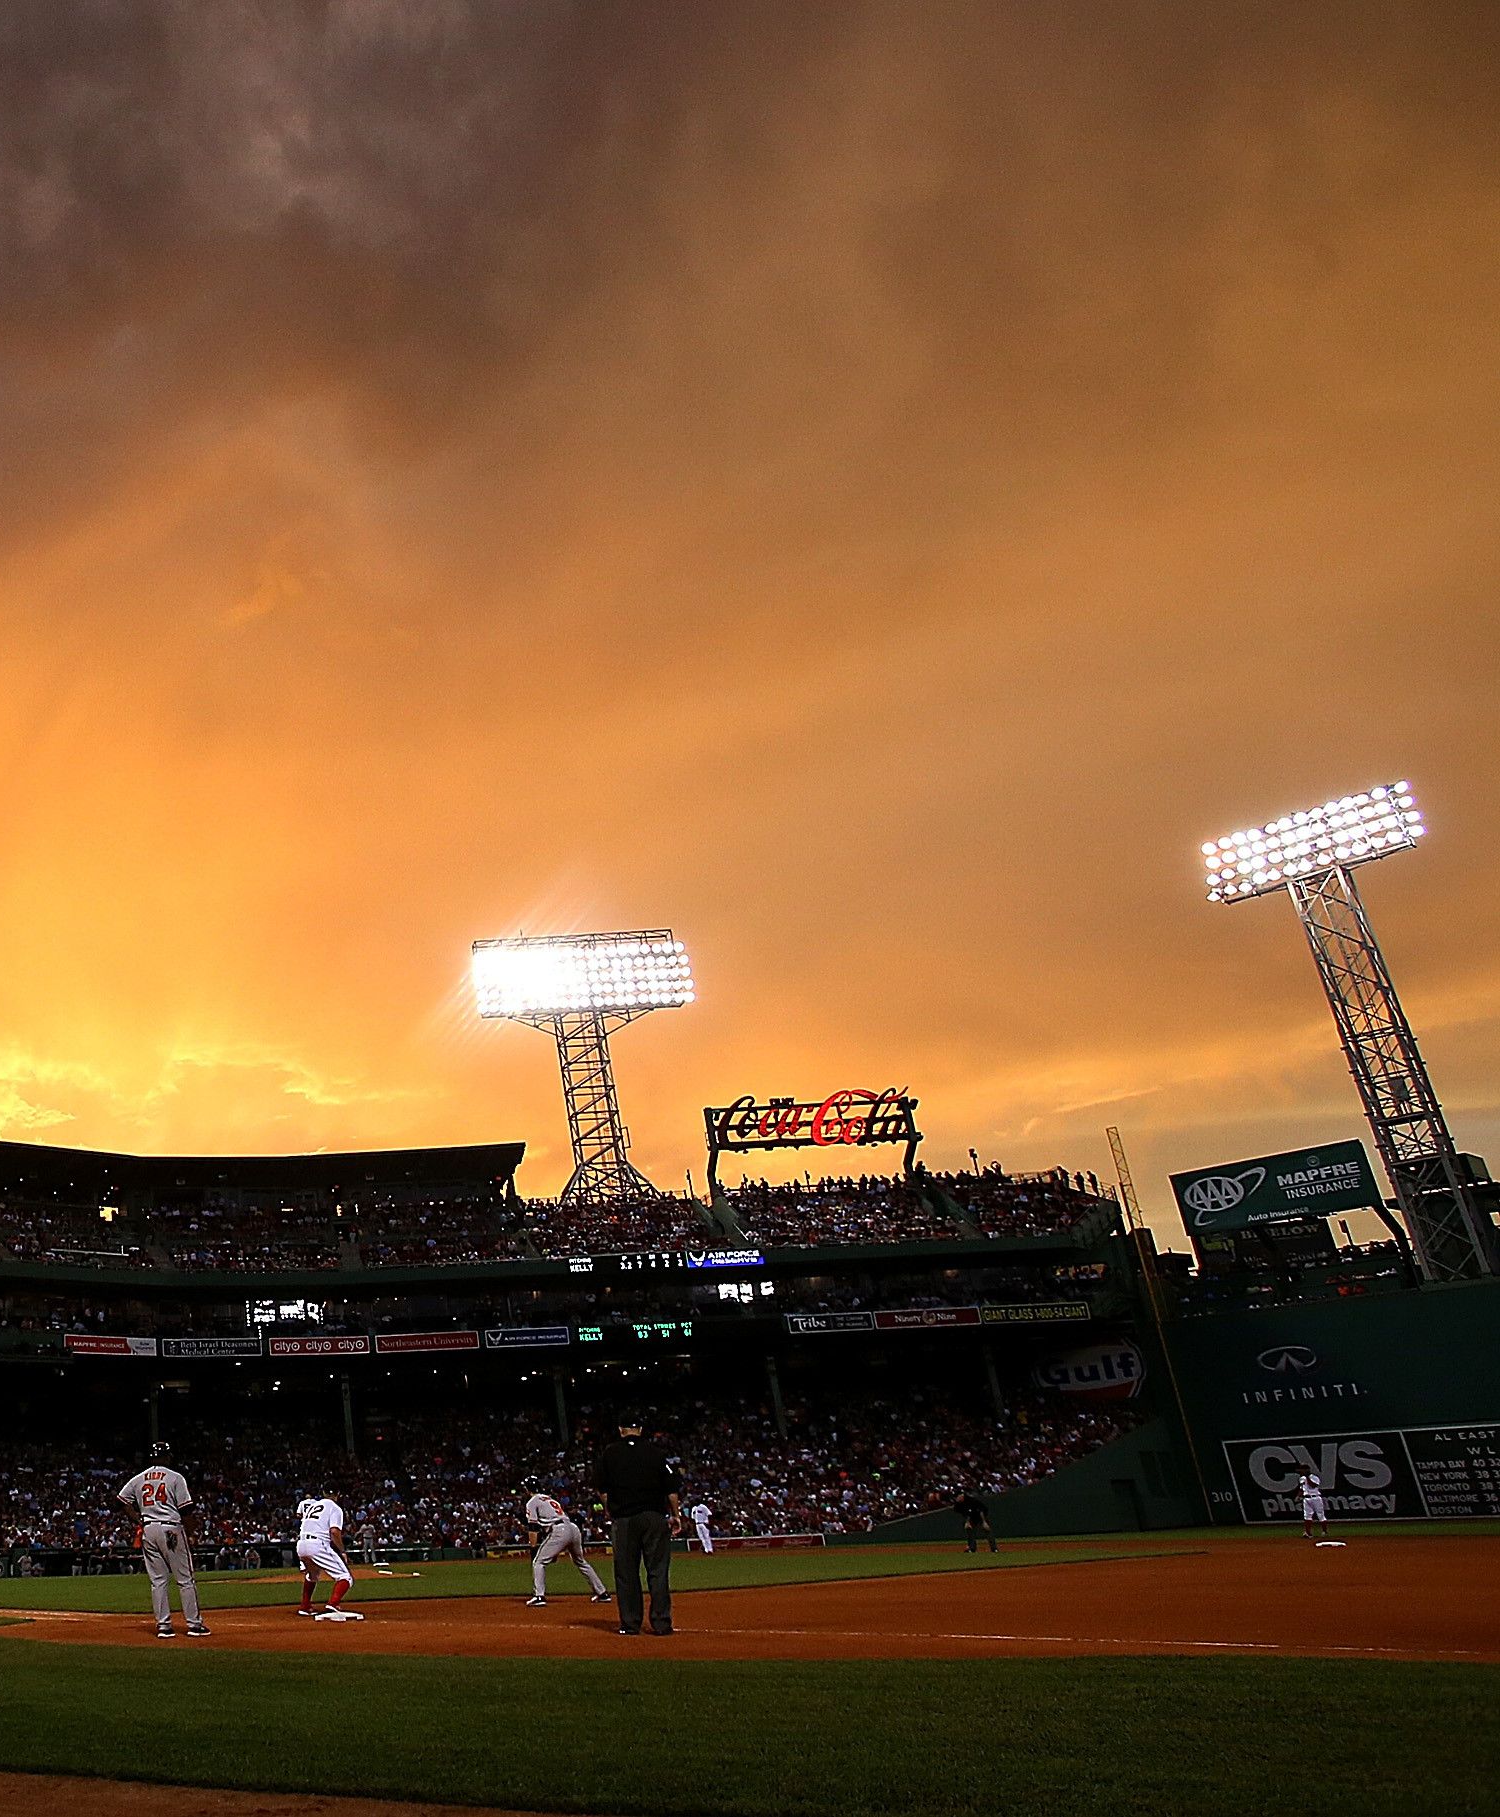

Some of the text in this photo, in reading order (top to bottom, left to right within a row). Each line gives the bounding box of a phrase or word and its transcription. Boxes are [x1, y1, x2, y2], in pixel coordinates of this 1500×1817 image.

[1276, 1161, 1361, 1188] MAPFRE
[1285, 1176, 1361, 1200] INSURANCE
[1192, 1179, 1236, 1210] AAA
[1247, 1205, 1310, 1223] Auto Insurance
[1240, 1224, 1320, 1240] BIELOW
[707, 1249, 760, 1259] AIR FORCE
[569, 1263, 594, 1273] KELLY
[637, 1260, 643, 1269] 7
[984, 1309, 1007, 1321] GIANT
[1008, 1308, 1034, 1320] GLASS
[1064, 1305, 1088, 1318] GIANT
[793, 1316, 827, 1332] Tribe
[579, 1332, 603, 1341] KELLY
[661, 1329, 670, 1338] 51
[199, 1340, 219, 1348] Israel
[432, 1335, 474, 1345] University
[181, 1347, 235, 1356] Medical Center
[1042, 1352, 1135, 1385] Gulf
[1242, 1383, 1360, 1405] INFINITI
[1434, 1430, 1496, 1441] AL EAST
[1466, 1445, 1496, 1455] W L
[1249, 1440, 1393, 1493] CVS
[1416, 1460, 1446, 1470] TAMPA
[1447, 1459, 1466, 1469] BAY
[1472, 1458, 1486, 1468] 40
[1419, 1472, 1441, 1481] NEW
[1443, 1470, 1471, 1480] YORK
[1474, 1469, 1491, 1479] 38
[1423, 1482, 1471, 1492] TORONTO
[141, 1482, 168, 1507] 24
[1211, 1490, 1233, 1504] 310
[1426, 1494, 1480, 1504] BALTIMORE
[1430, 1505, 1474, 1515] BOSTON
